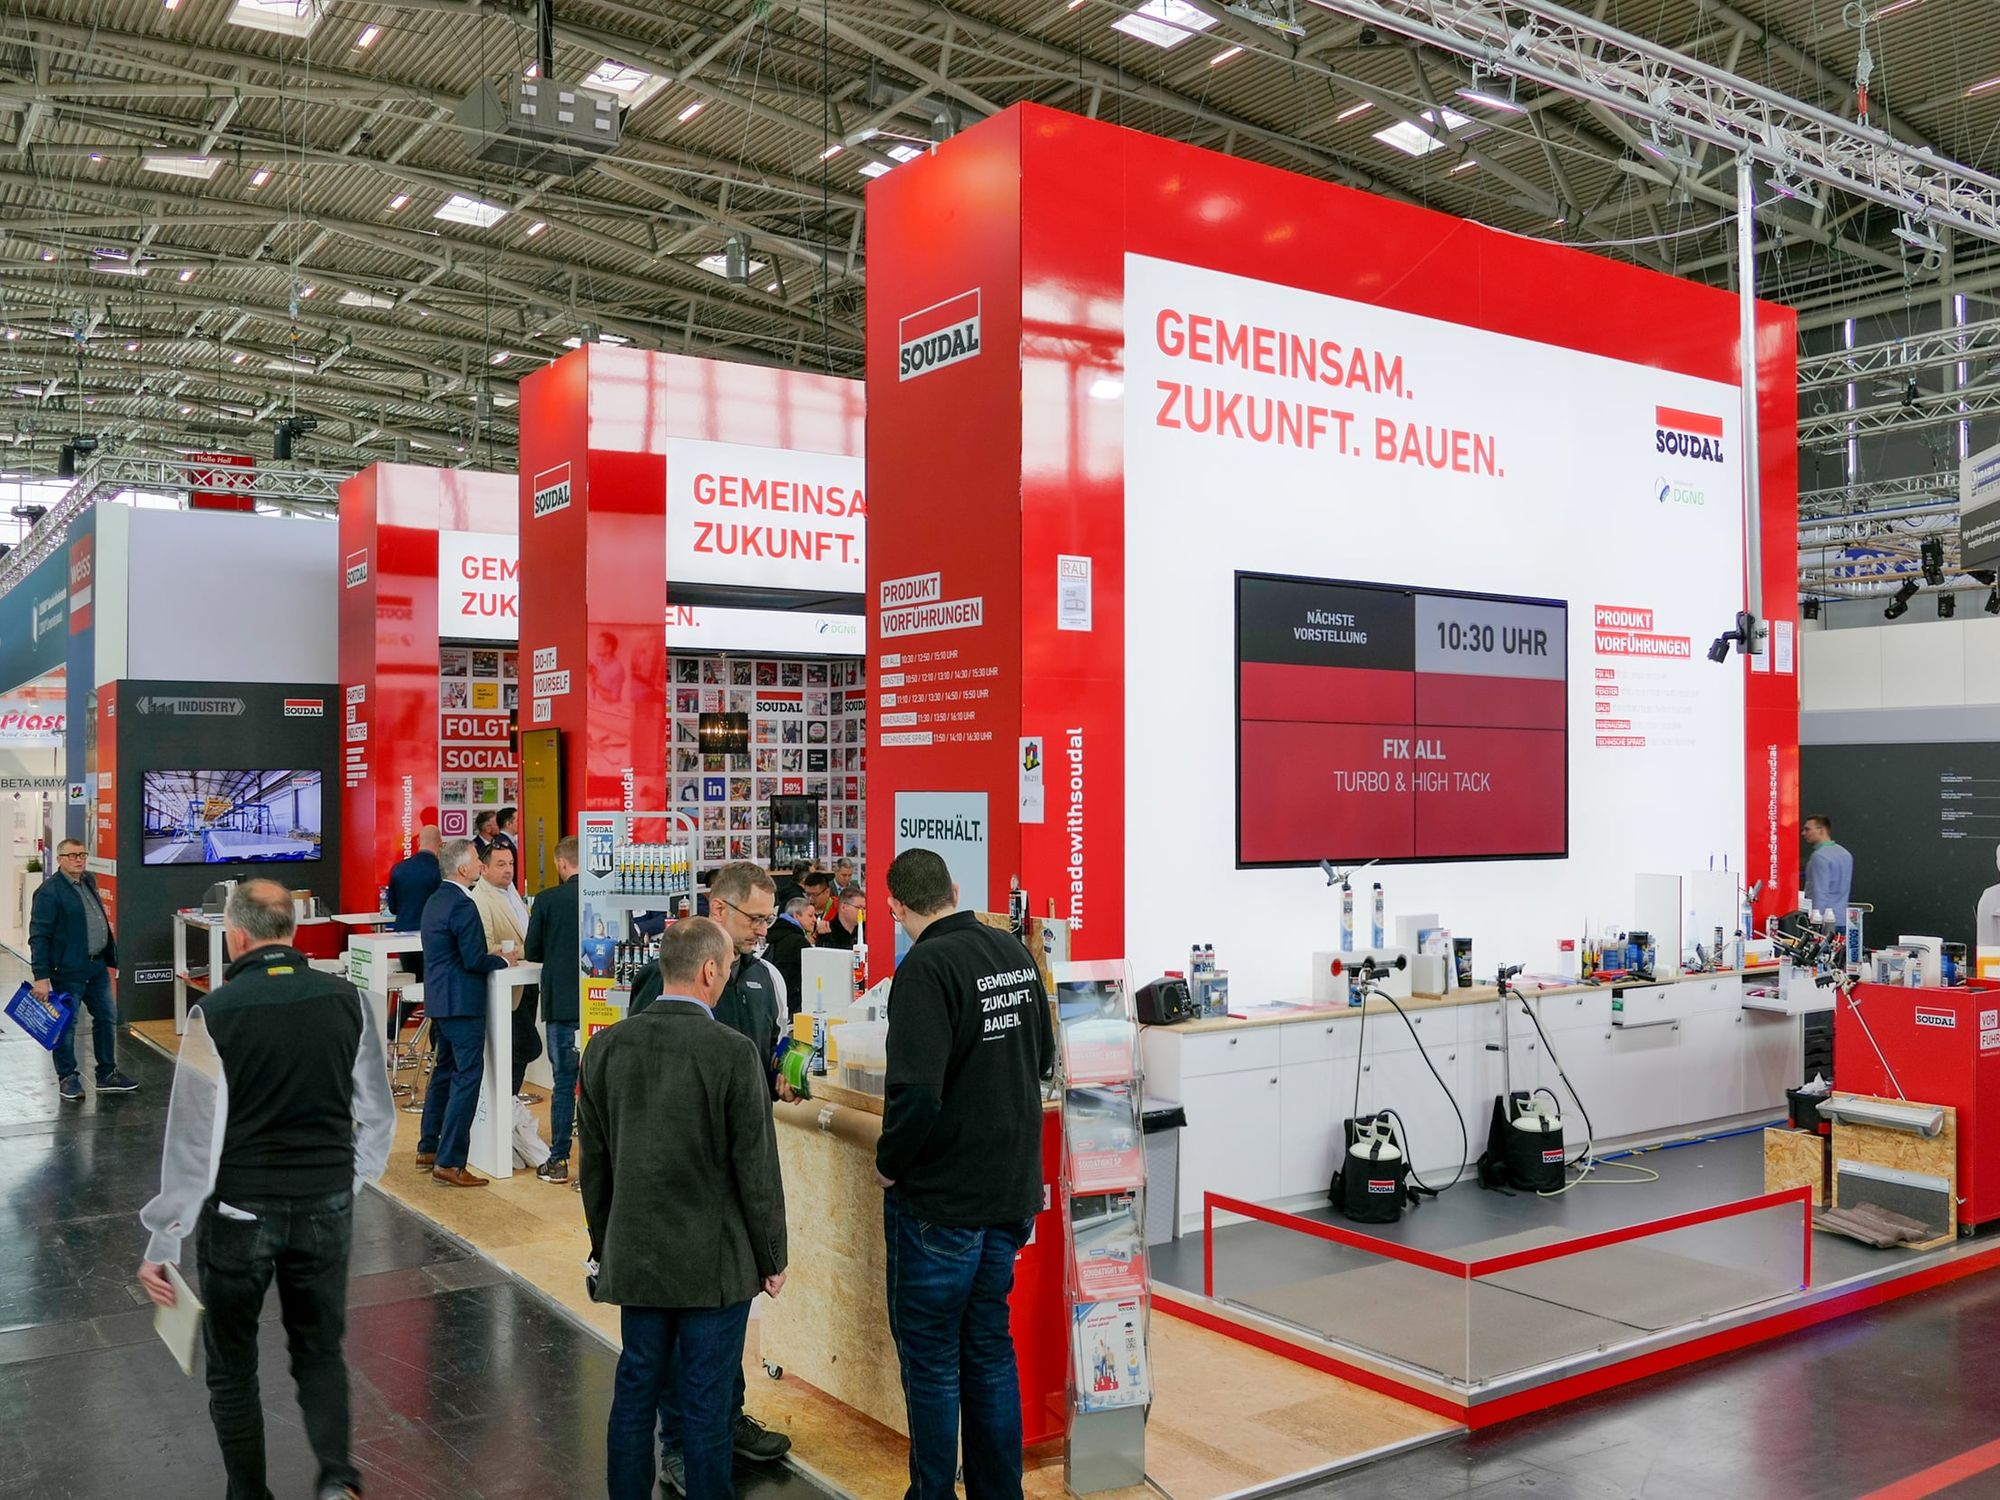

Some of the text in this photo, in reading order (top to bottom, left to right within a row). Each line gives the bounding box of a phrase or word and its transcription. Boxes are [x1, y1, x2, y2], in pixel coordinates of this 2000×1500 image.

[901, 324, 979, 374] SOUDAL
[1156, 308, 1413, 400] GEMEINSAM.
[1156, 379, 1504, 478] ZUKUNFT. BAUEN.
[1656, 429, 1723, 463] SOUDAL
[534, 483, 570, 514] SOUDAL
[1673, 488, 1705, 506] DGNB
[693, 521, 860, 564] ZUKUNFT.
[71, 552, 91, 581] weiss
[883, 577, 938, 603] PRODUKT
[882, 602, 979, 633] VORFÜHRUNGEN
[1307, 609, 1355, 627] NÄCHSTE
[1597, 610, 1651, 628] PRODUKT
[1293, 627, 1368, 645] VORSTELLUNG
[1437, 622, 1547, 656] 10:30 UHR
[1596, 633, 1689, 655] VORFÜHRUNGEN
[535, 652, 555, 669] DO-IT-
[946, 650, 958, 659] UHR
[986, 667, 998, 676] UHR
[535, 674, 568, 693] YOURSELF
[976, 689, 989, 698] UHR
[178, 700, 236, 713] INDUSTRY
[285, 707, 323, 716] SOUDAL
[756, 702, 803, 713] SOUDAL
[964, 711, 976, 720] UHR
[446, 718, 510, 737] FOLGT
[980, 732, 992, 740] UHR
[1383, 738, 1446, 760] FIX ALL
[445, 750, 519, 769] SOCIAL
[1, 778, 31, 788] BETA
[784, 783, 801, 791] 50%
[1333, 771, 1491, 792] TURBO & HIGH TACK
[1768, 744, 1777, 891] #madewithsoudal
[900, 814, 983, 842] SUPERHÄLT.
[1066, 727, 1084, 931] #madewithsoudal
[147, 972, 171, 980] SAPAC
[1917, 1015, 1954, 1027] SOUDAL
[1982, 1014, 1996, 1026] VOR
